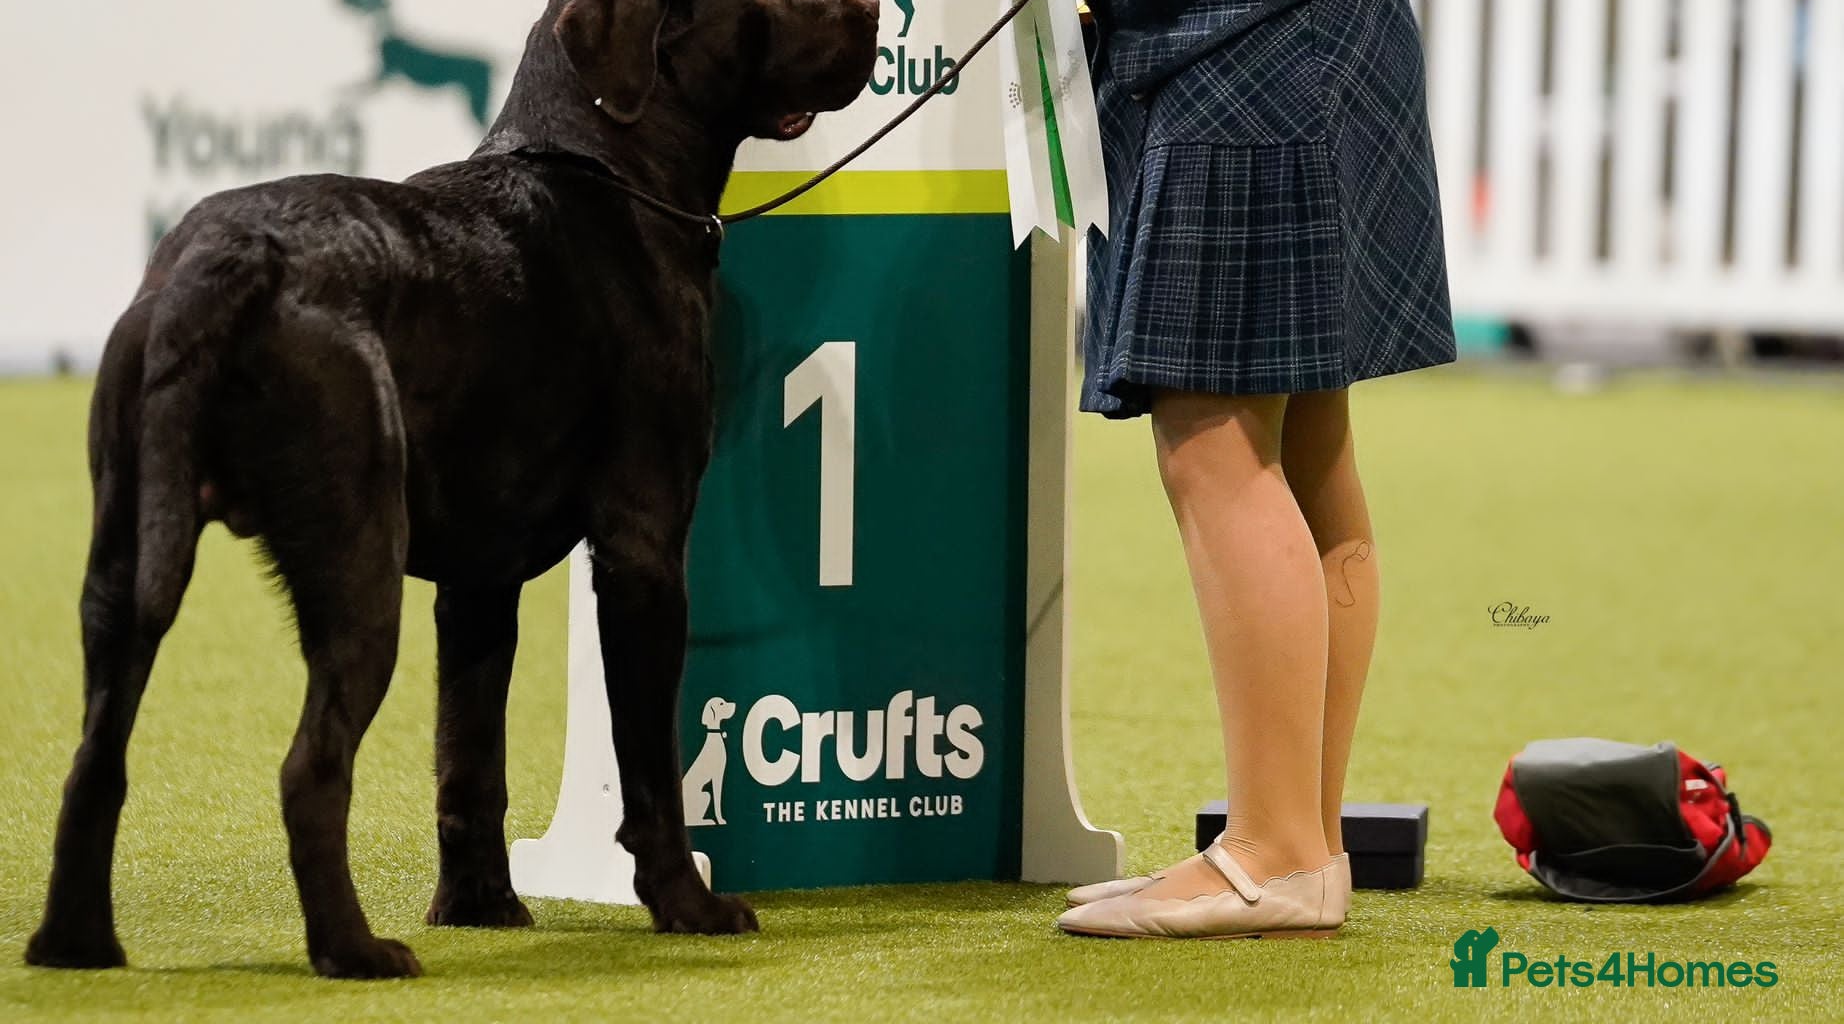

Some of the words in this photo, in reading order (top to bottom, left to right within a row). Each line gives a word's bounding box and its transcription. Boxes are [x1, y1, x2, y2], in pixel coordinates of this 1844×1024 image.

[869, 45, 959, 95] Club
[140, 89, 364, 178] Young
[784, 341, 855, 586] 1
[742, 690, 984, 786] Crufts
[763, 801, 805, 823] THE
[815, 797, 901, 821] KENNEL
[909, 795, 963, 817] CLUB
